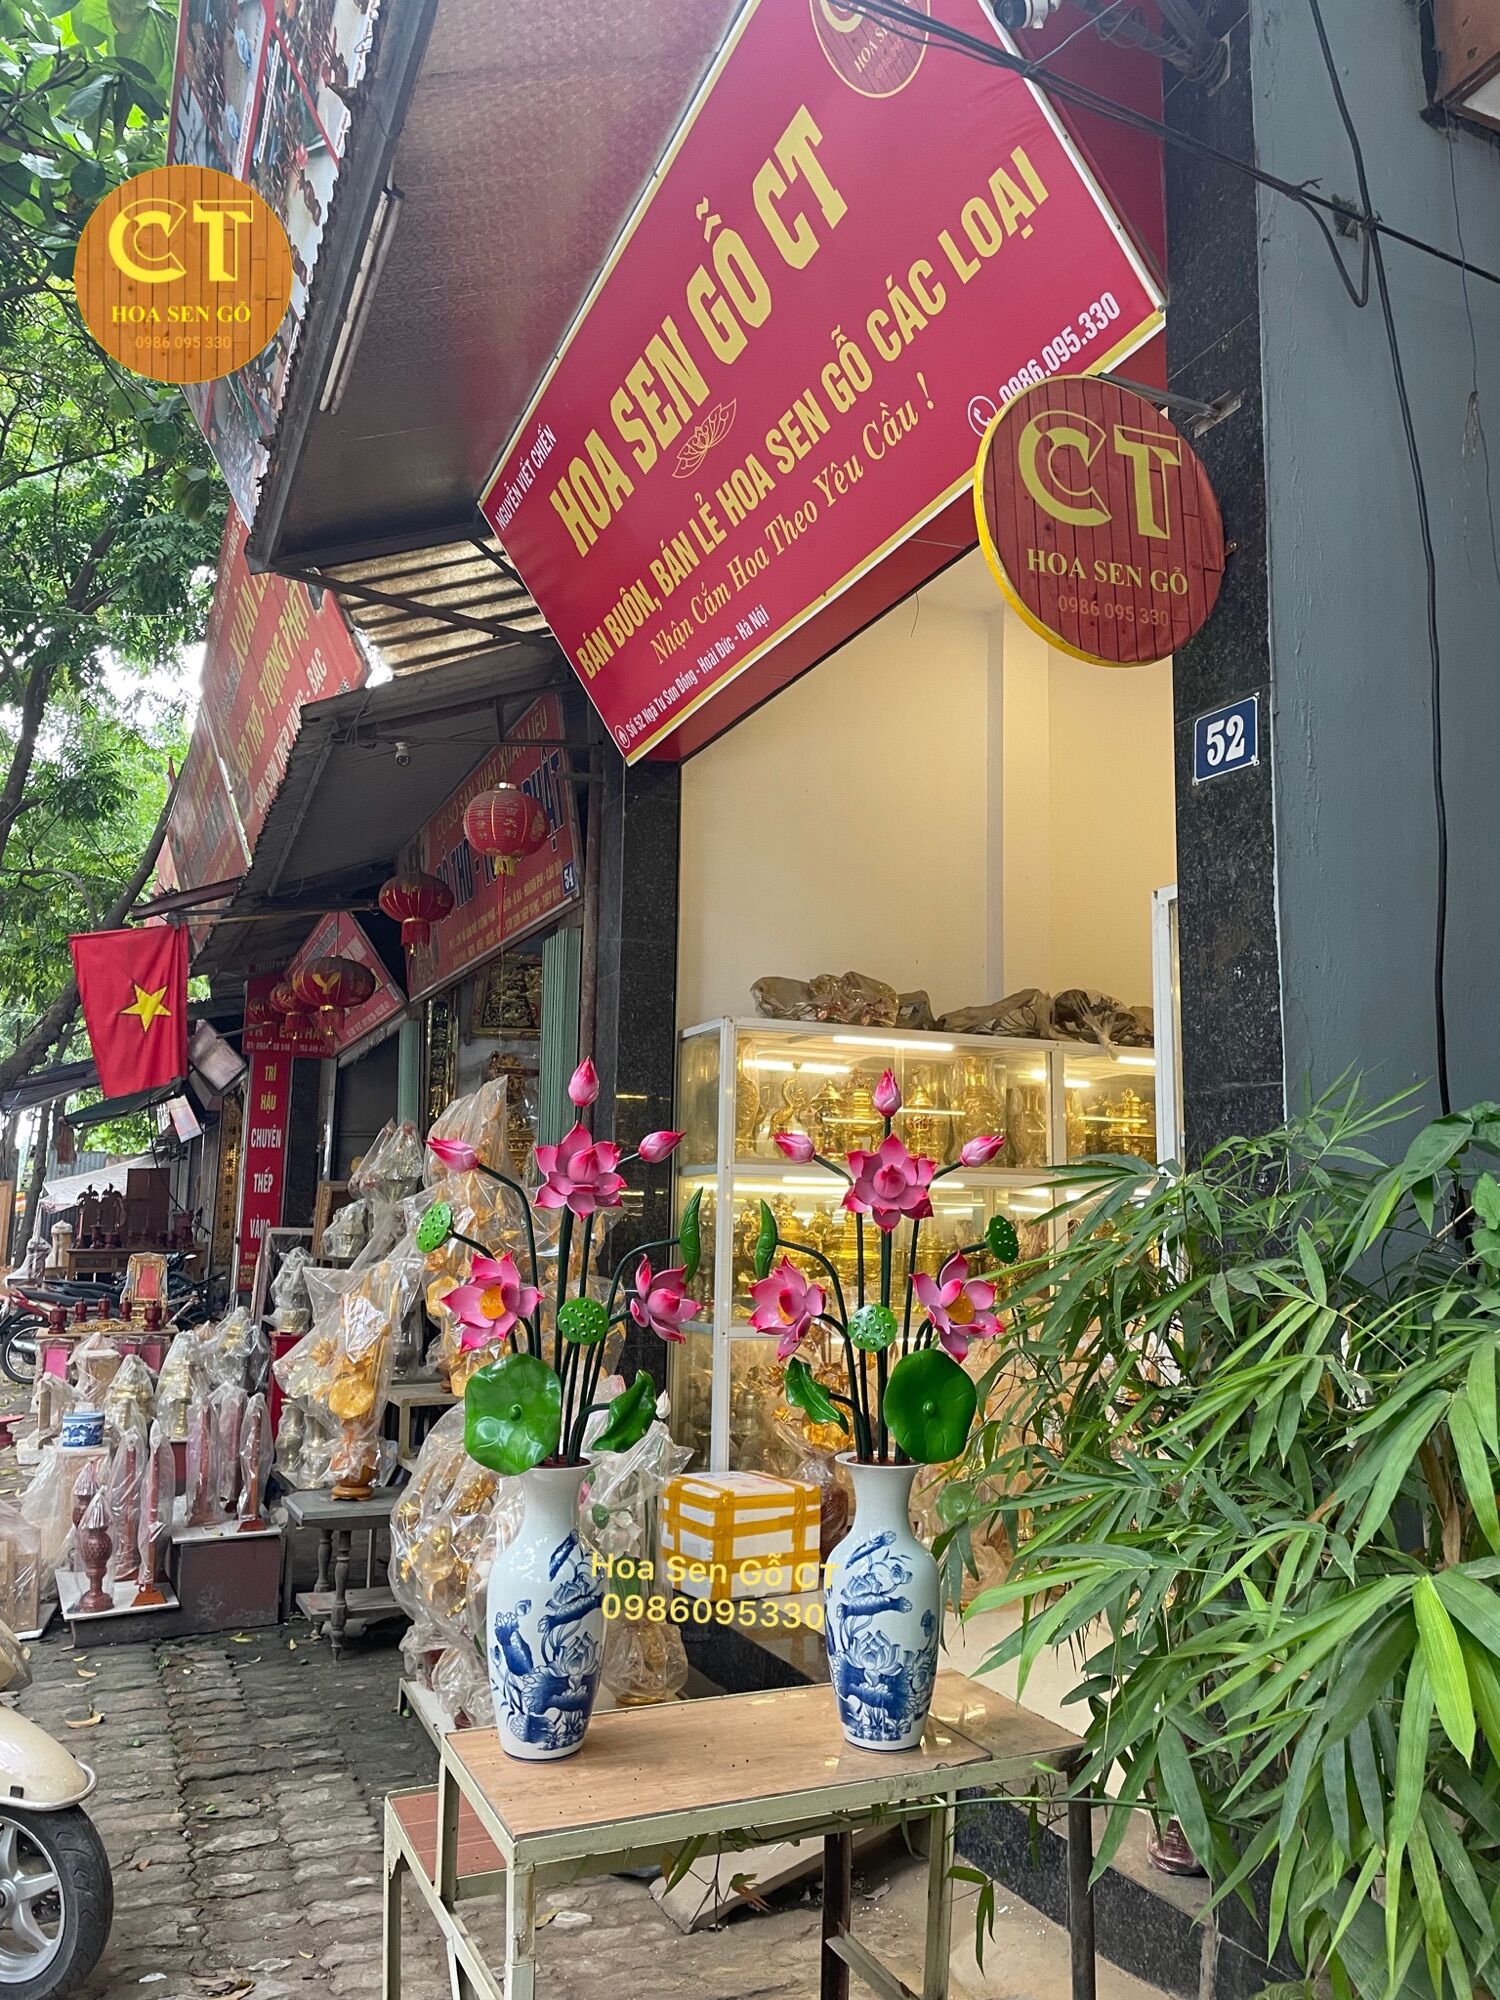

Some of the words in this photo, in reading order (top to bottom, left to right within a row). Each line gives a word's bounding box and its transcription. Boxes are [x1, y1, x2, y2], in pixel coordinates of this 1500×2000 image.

[550, 428, 635, 558] HOA
[610, 314, 711, 475] SEN
[686, 197, 772, 365] GỖ
[752, 104, 848, 270] CT
[576, 626, 615, 680] BÁN
[603, 579, 663, 648] BUÔN,
[649, 530, 700, 597] BÁN
[688, 492, 727, 556] LẺ
[715, 453, 776, 527] HOA
[765, 388, 831, 474] SEN
[821, 324, 873, 414] GỖ
[866, 259, 946, 362] CÁC
[937, 145, 1050, 284] LOẠI
[495, 481, 523, 531] NGUYỄN
[516, 456, 536, 493] VIẾT
[530, 423, 557, 470] CHIẾN
[1018, 409, 1182, 540] CT
[650, 618, 694, 665] Nhận
[690, 581, 731, 625] Cắm
[726, 546, 770, 592] Hoa
[764, 500, 818, 556] Theo
[812, 454, 864, 508] Yêu
[862, 400, 919, 460] Cầu
[1027, 548, 1086, 579] HOA
[1094, 560, 1143, 589] SEN
[1150, 566, 1189, 596] GỖ
[1058, 595, 1101, 617] 0986
[1104, 602, 1135, 623] 095
[1139, 607, 1169, 627] 330
[306, 647, 328, 696] BẠC
[633, 713, 646, 731] 52
[697, 648, 720, 674] Hoài
[715, 634, 736, 659] Đức
[736, 618, 754, 641] Hà
[749, 604, 770, 628] Nội
[1205, 713, 1246, 767] 52
[563, 865, 575, 890] 54
[264, 1063, 277, 1082] TRÍ
[260, 1092, 277, 1114] HẬU
[250, 1124, 282, 1149] CHUYÊN
[253, 1166, 274, 1194] THẾP
